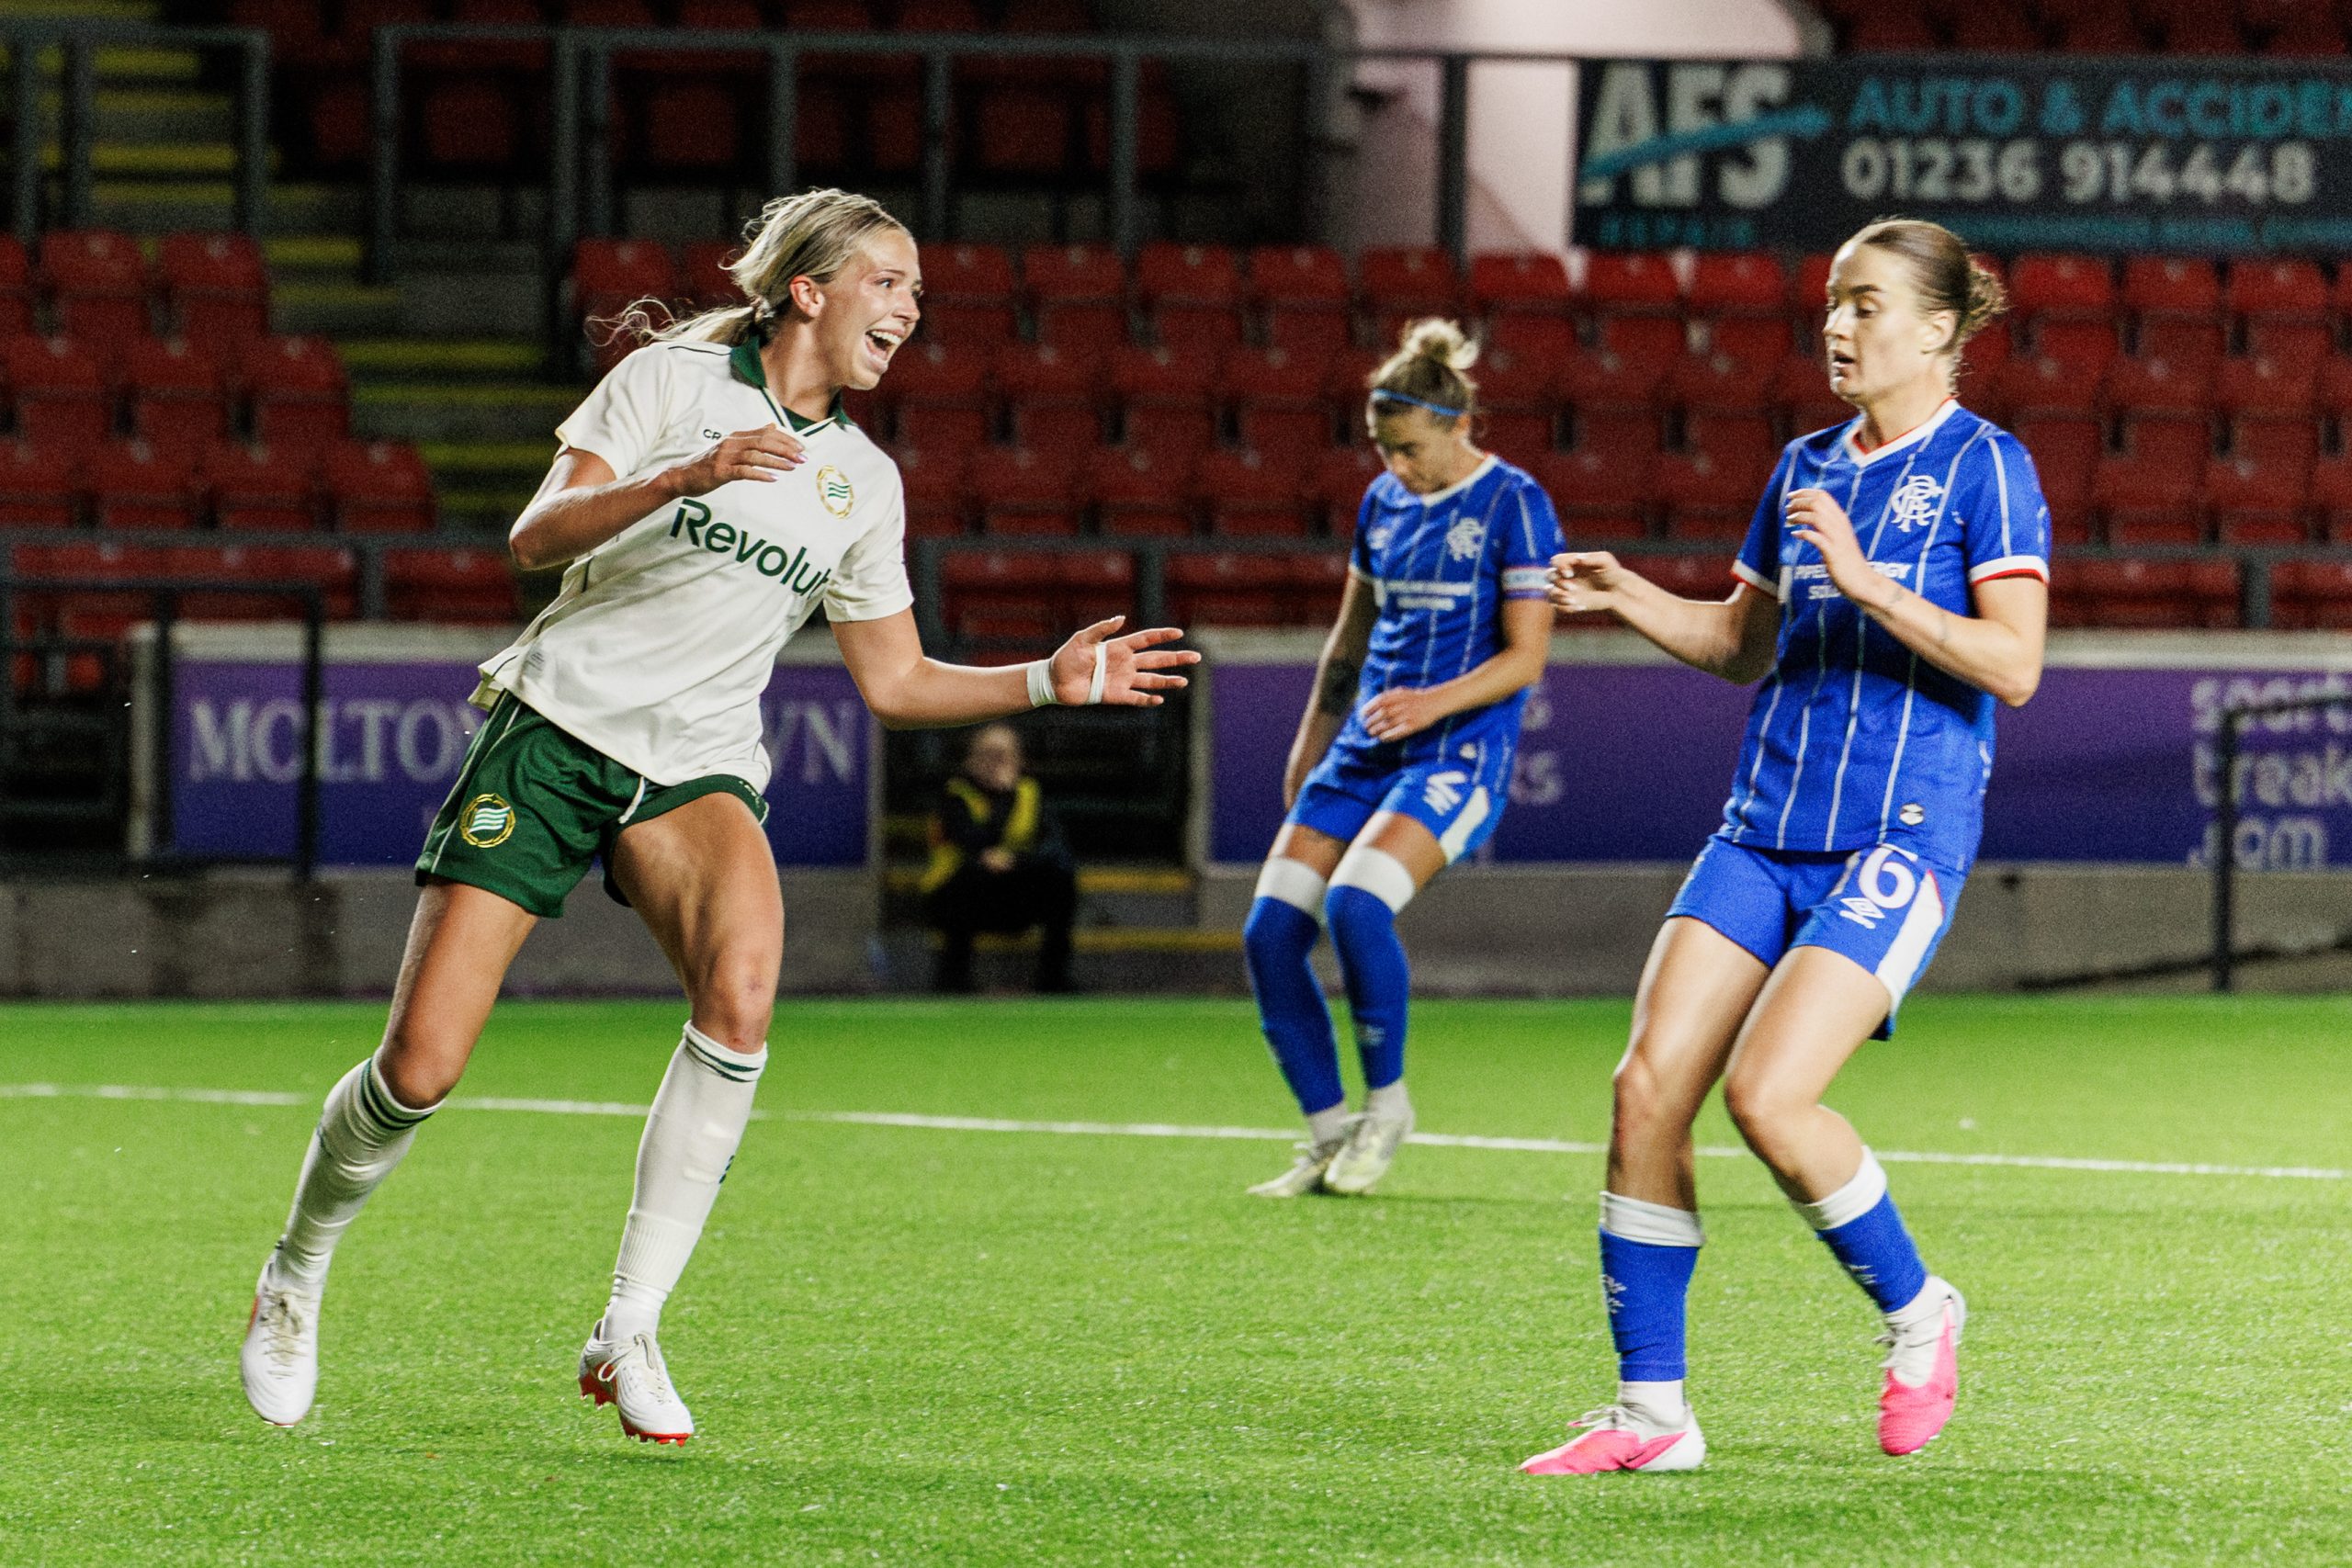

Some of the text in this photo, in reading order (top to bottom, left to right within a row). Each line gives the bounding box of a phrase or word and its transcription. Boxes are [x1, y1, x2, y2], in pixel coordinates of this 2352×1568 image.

[1849, 78, 2022, 135] AUTO
[2041, 81, 2083, 136] &
[1841, 138, 2315, 204] 01236 914448
[188, 698, 482, 783] MOLTO
